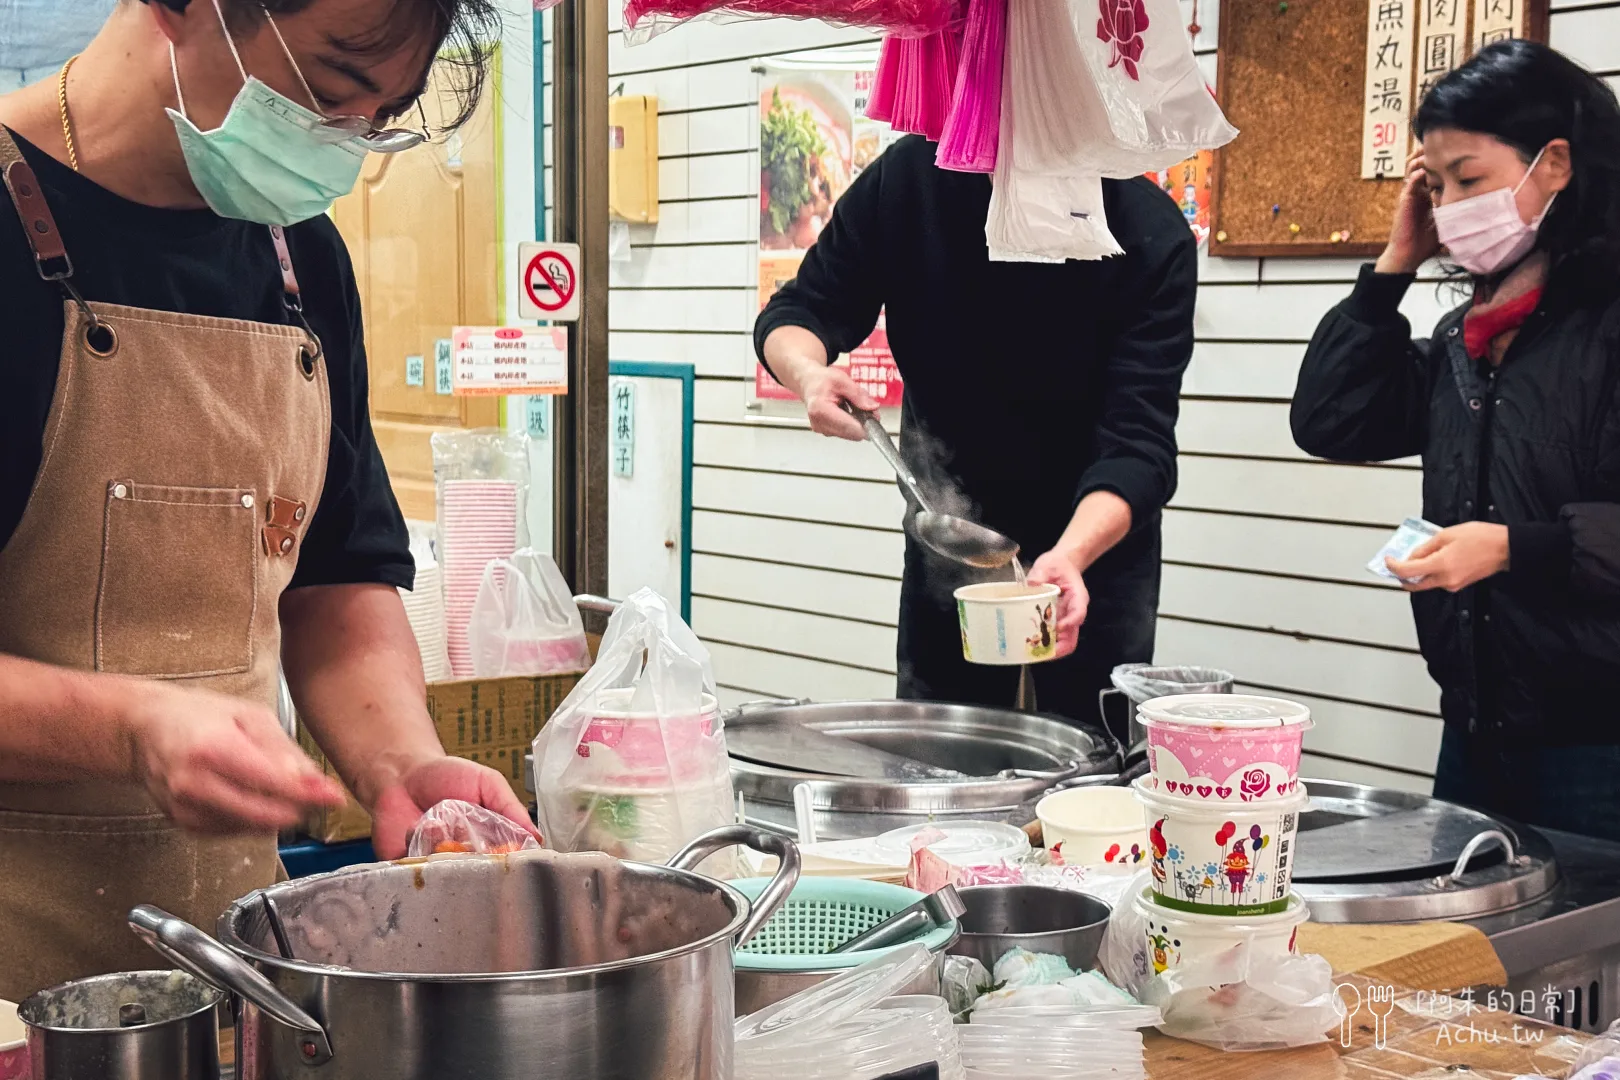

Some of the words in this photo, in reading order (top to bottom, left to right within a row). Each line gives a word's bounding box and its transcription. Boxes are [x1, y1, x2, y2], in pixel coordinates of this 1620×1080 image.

[617, 386, 630, 472] 竹筷子
[1167, 782, 1230, 798] LOVE
